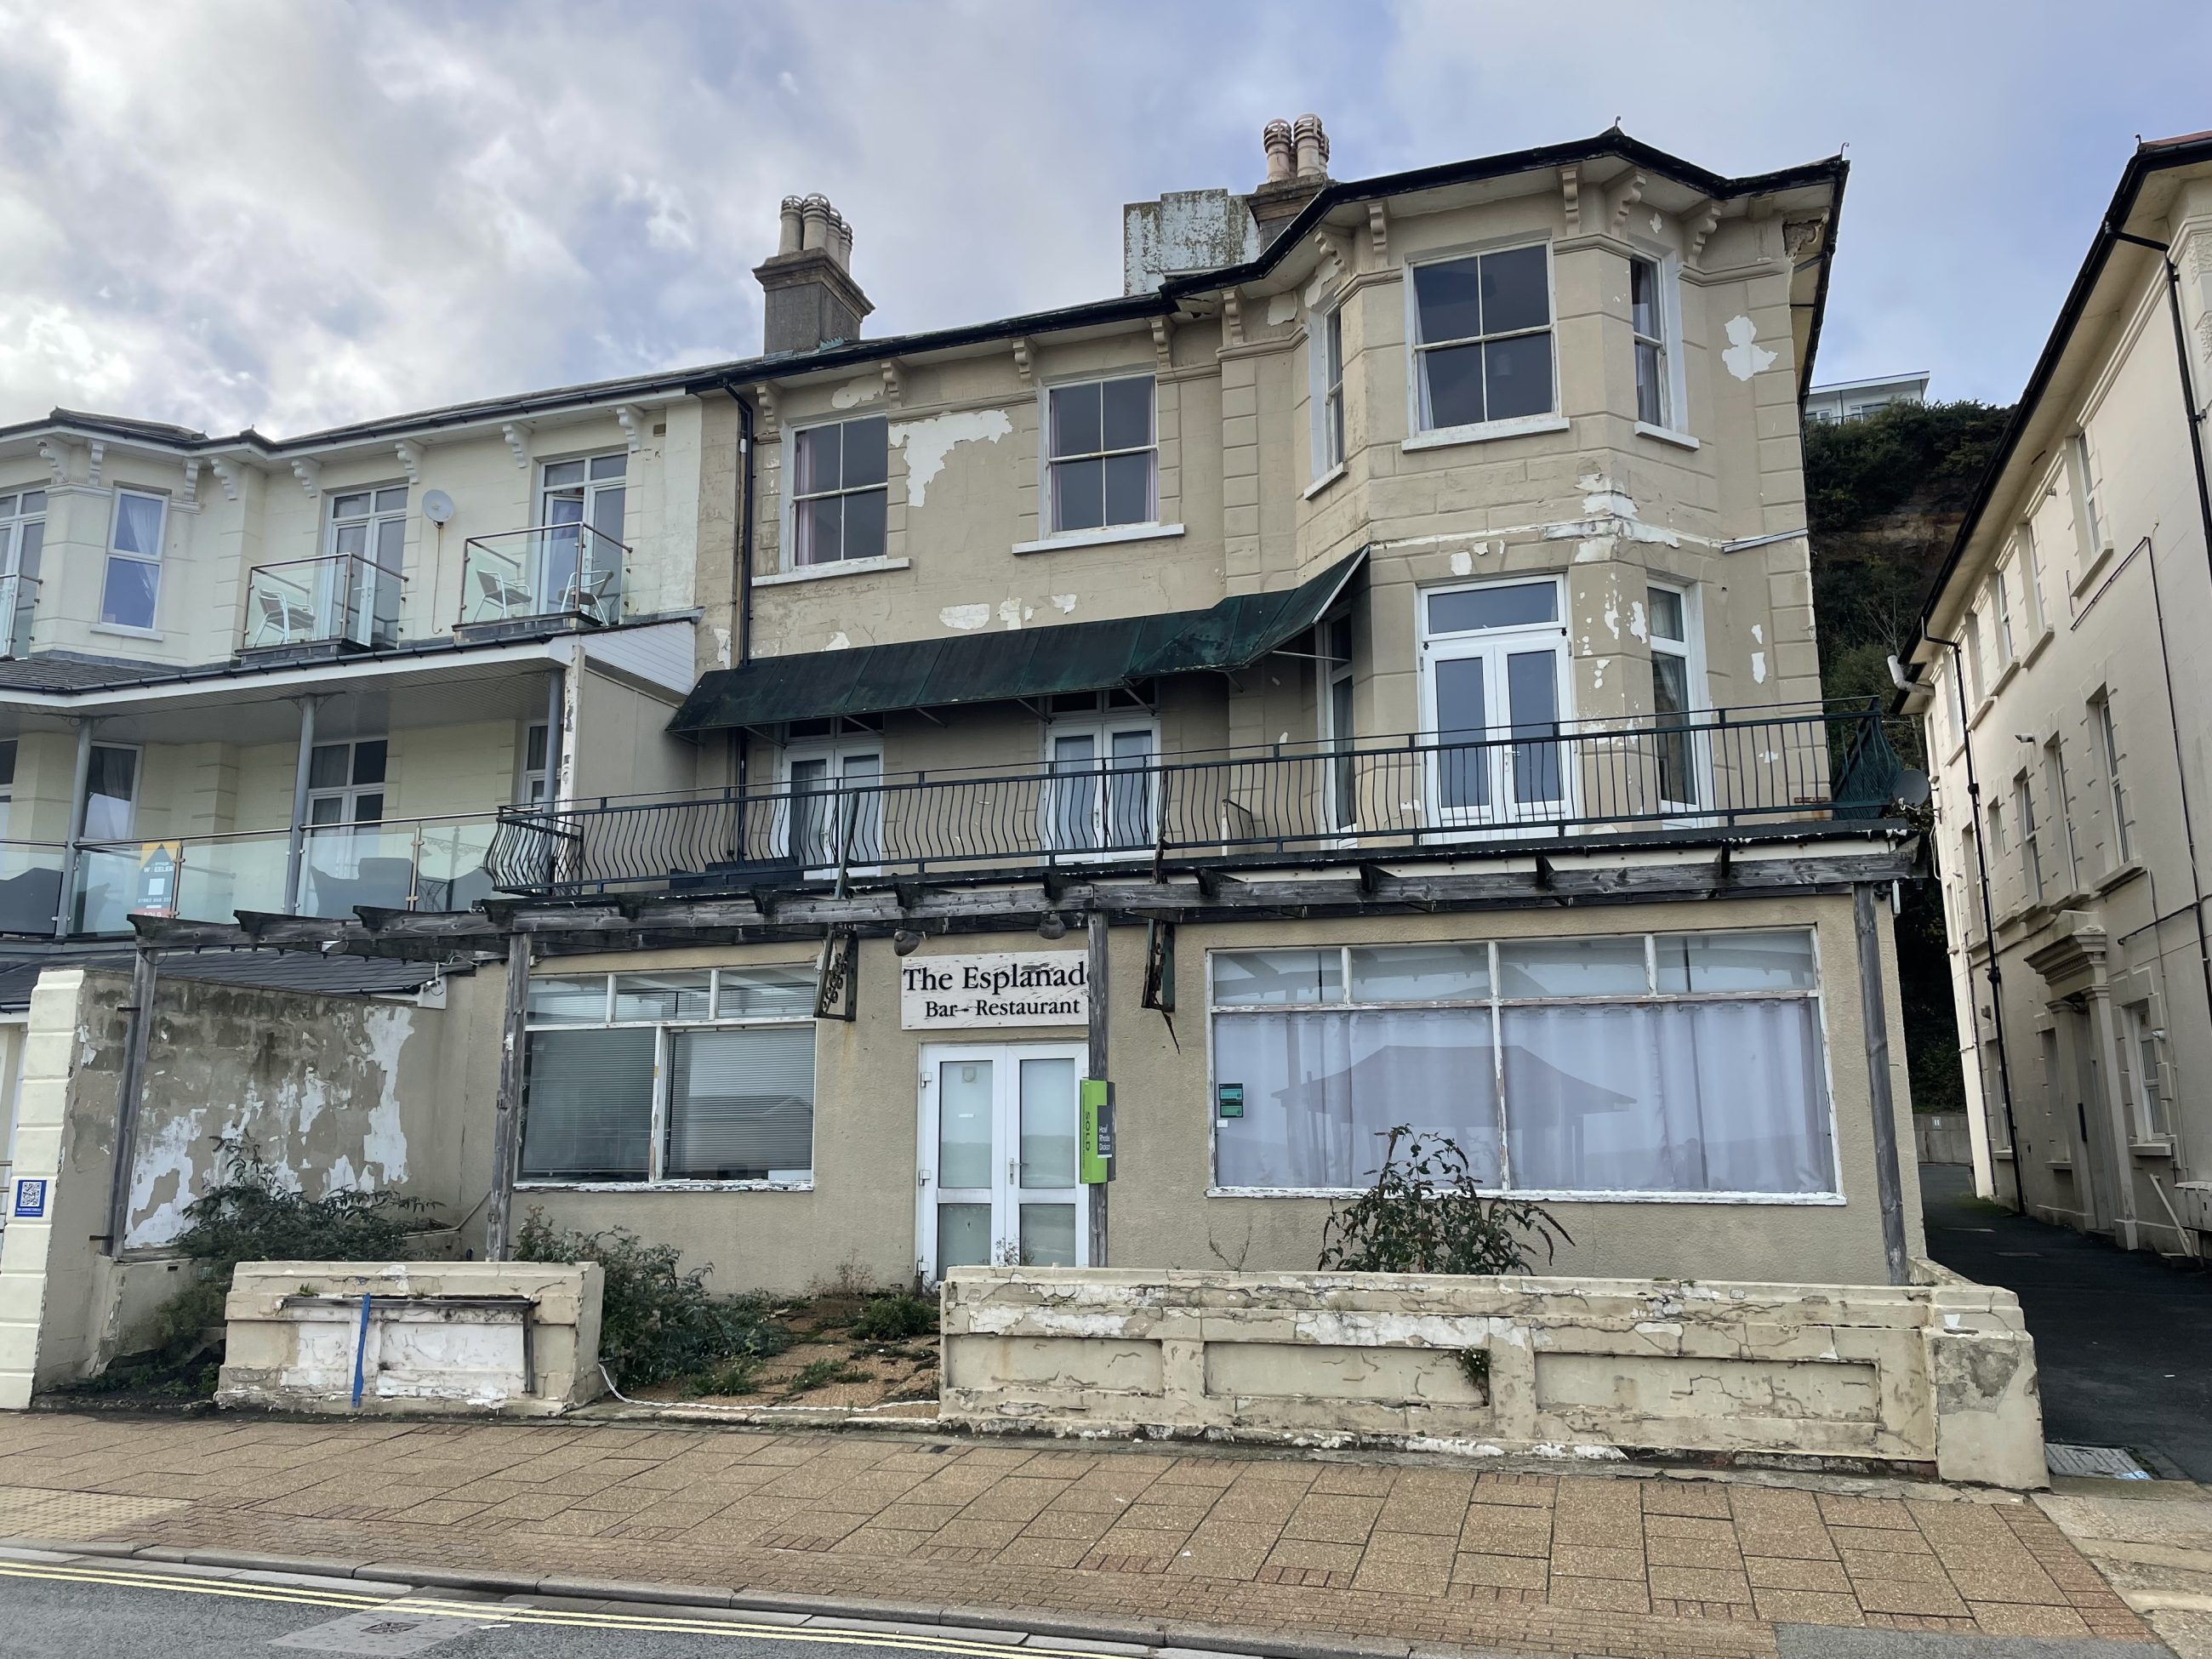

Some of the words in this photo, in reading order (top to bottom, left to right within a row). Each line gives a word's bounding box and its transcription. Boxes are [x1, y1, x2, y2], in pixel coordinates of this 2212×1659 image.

[903, 966, 953, 991] The
[961, 961, 1090, 995] Esplanad
[976, 999, 1080, 1016] Restaurant
